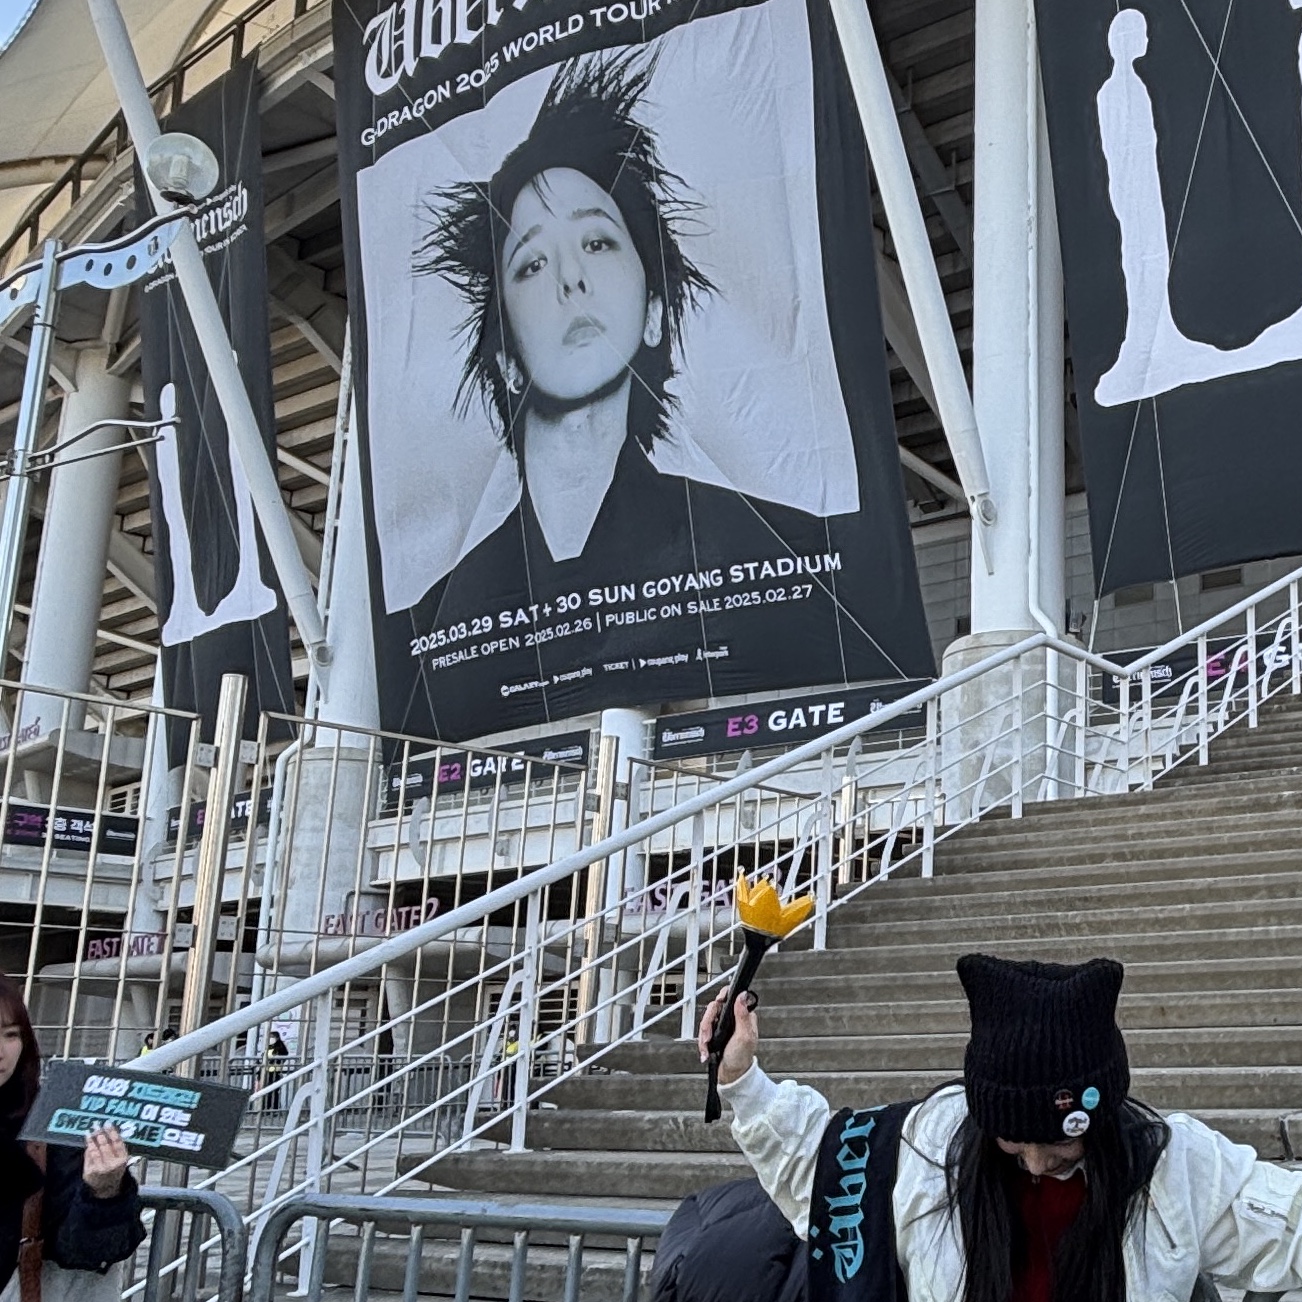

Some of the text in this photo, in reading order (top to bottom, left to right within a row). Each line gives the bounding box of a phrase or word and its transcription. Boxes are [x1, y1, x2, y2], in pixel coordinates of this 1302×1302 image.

[361, 0, 661, 146] G-DRAGON 2025 WORLD TOUR
[410, 616, 493, 656] 2025.03.29
[499, 604, 539, 629] SAT
[556, 592, 582, 613] 30
[588, 583, 636, 606] SUN
[642, 568, 723, 598] GOYANG
[729, 552, 842, 583] STADIUM
[432, 584, 813, 671] PRESALE OPEN 2025.02.26 PUBLIC ON SALE 2025.02.27
[726, 714, 759, 738] E3
[768, 701, 845, 732] GATE
[439, 762, 461, 783] E2
[323, 912, 371, 935] EAT
[88, 936, 120, 960] EAST
[80, 1094, 107, 1111] VIP
